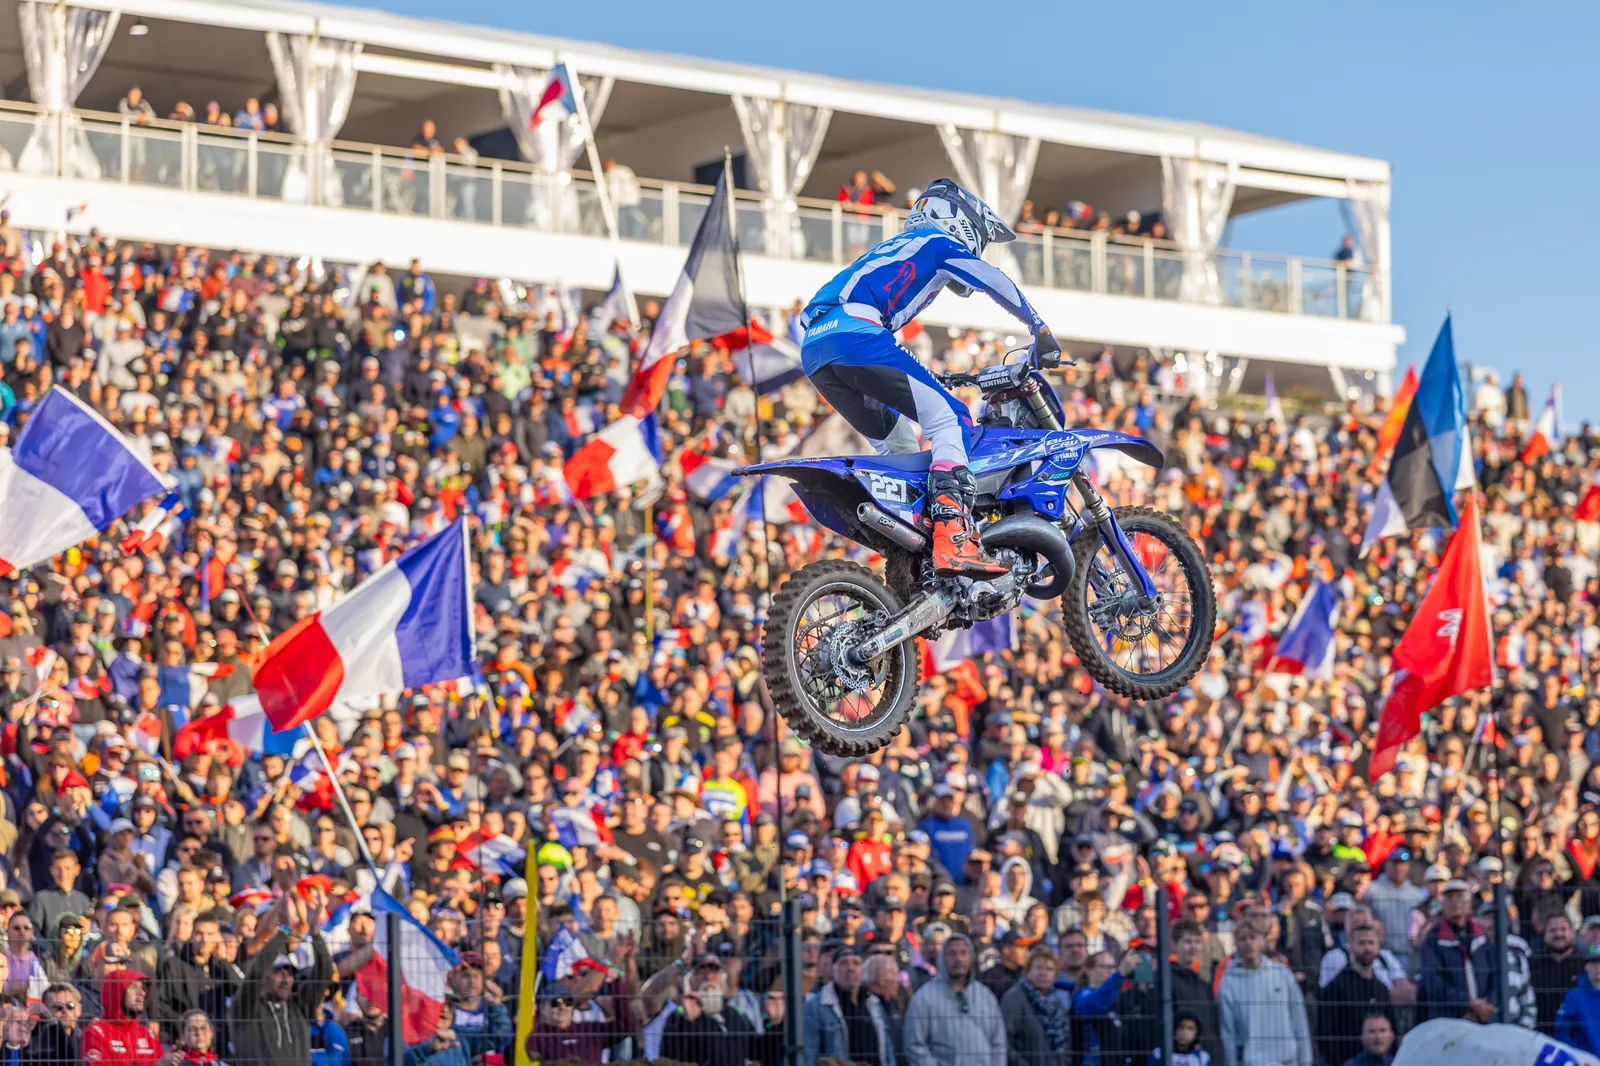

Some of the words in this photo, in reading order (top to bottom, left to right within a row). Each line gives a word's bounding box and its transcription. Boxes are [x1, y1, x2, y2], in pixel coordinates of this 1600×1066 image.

[959, 219, 975, 242] SHOT
[807, 319, 839, 338] YAMAHA
[980, 377, 1010, 388] RENTHAL
[1050, 440, 1078, 450] CRU
